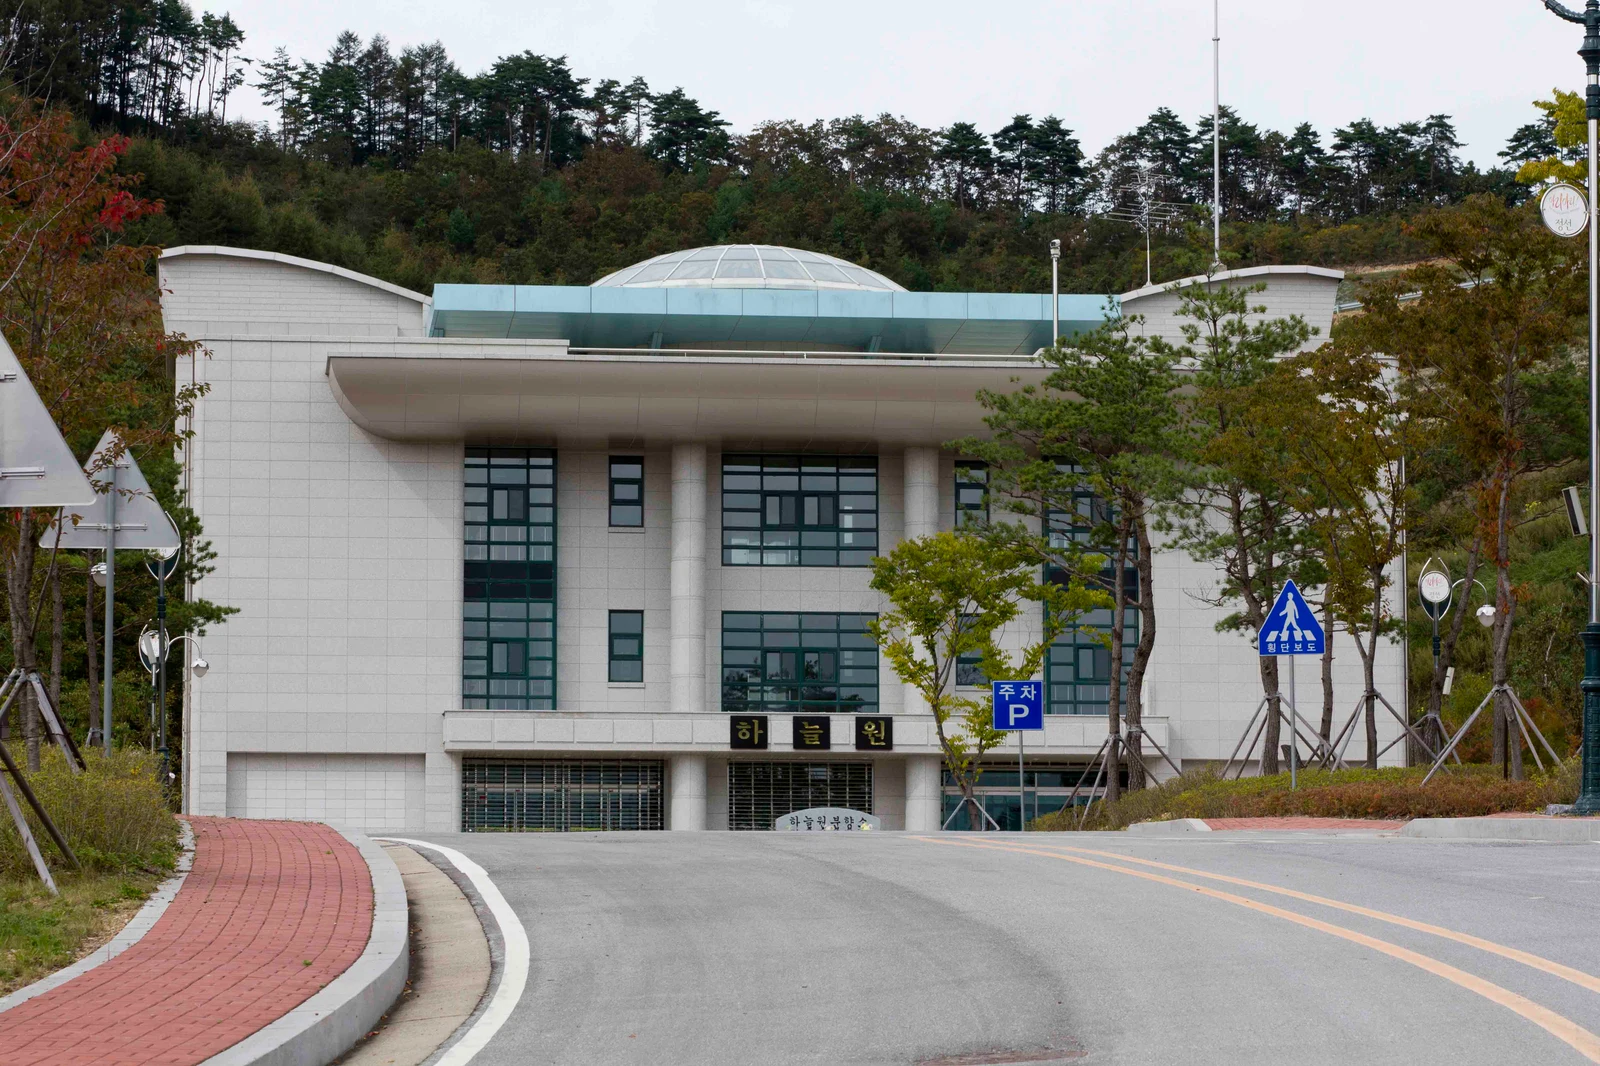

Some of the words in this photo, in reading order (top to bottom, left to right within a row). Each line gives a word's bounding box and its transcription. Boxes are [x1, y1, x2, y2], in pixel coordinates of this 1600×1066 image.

[1555, 218, 1574, 232] 정선
[1267, 642, 1317, 653] 횡단보도
[998, 684, 1037, 701] 주차
[1009, 704, 1030, 726] P
